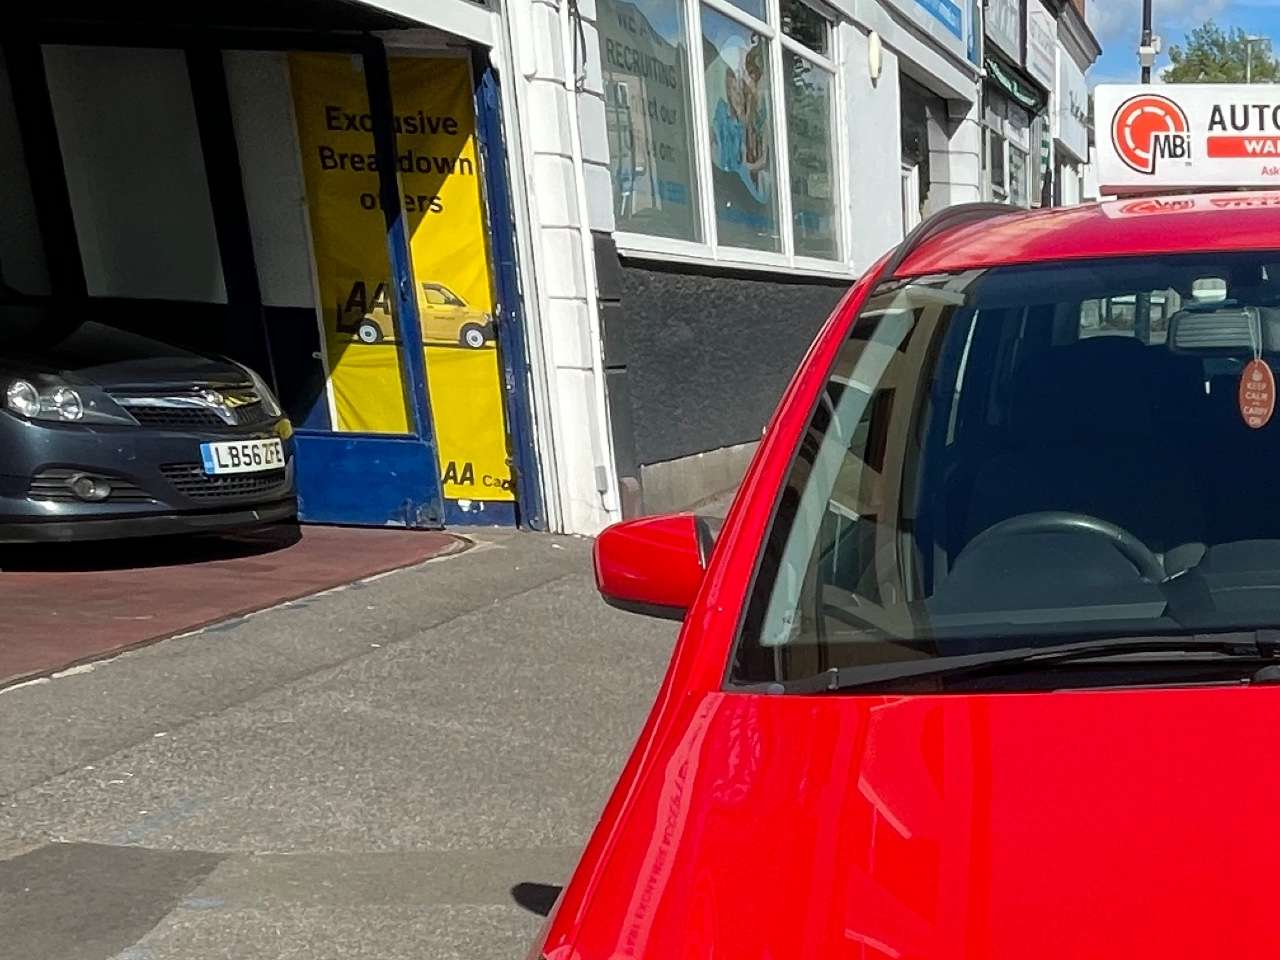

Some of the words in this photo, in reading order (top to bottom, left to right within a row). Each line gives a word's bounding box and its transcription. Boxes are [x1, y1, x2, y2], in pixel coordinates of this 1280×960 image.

[606, 38, 677, 89] RECRUITING
[325, 105, 459, 136] Excusive
[318, 146, 473, 175] Breadown
[1261, 166, 1280, 176] Ask
[360, 192, 443, 214] oers
[215, 443, 261, 469] LB56
[261, 442, 282, 465] ZFE
[443, 462, 475, 486] AA
